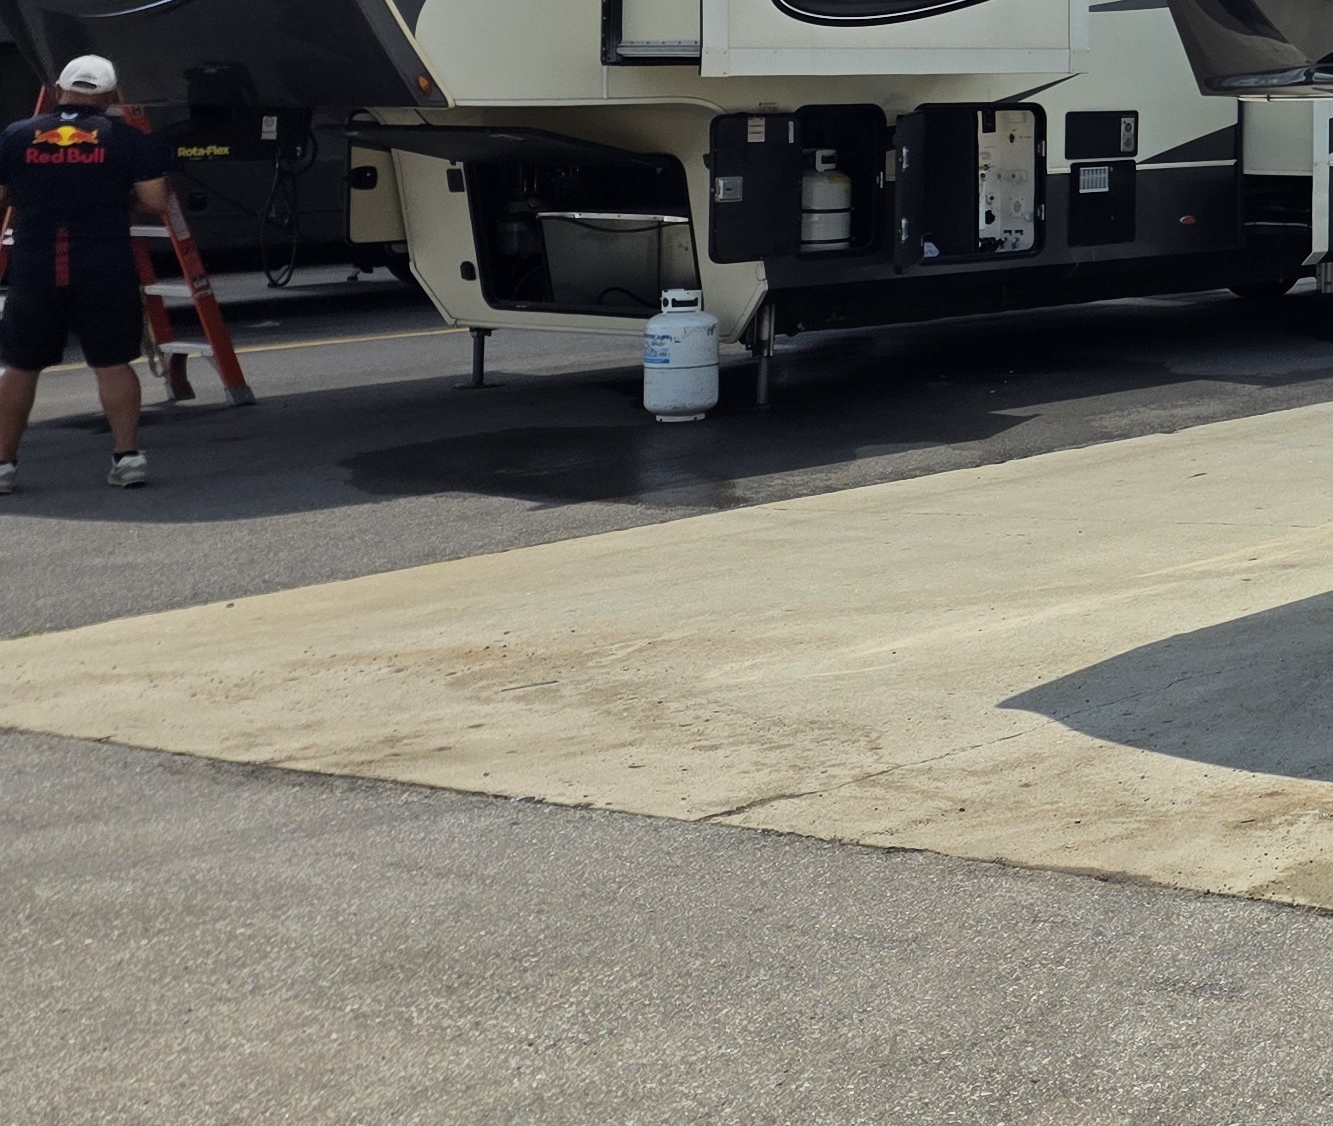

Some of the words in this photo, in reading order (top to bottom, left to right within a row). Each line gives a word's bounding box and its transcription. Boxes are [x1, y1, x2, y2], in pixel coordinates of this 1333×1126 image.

[26, 147, 64, 164] Red
[66, 147, 105, 164] Bull
[178, 145, 230, 157] Rota-Flex
